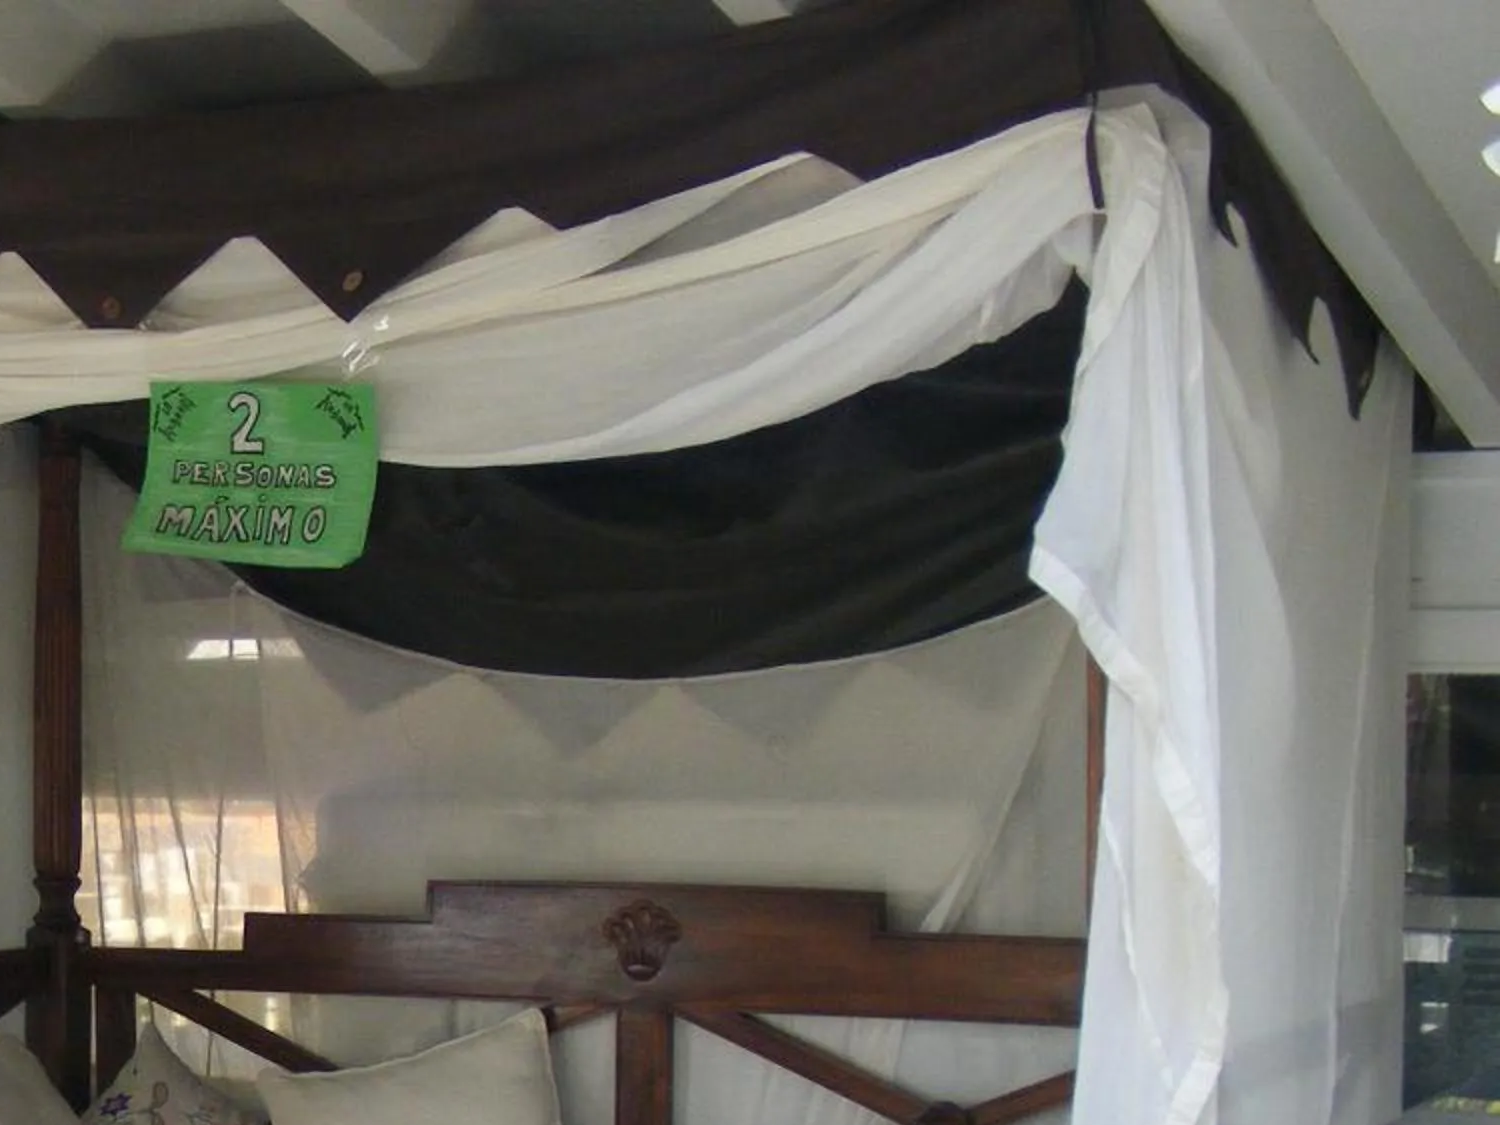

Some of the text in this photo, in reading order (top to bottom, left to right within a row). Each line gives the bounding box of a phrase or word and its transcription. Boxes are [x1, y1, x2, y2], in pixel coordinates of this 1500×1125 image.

[227, 391, 265, 455] 2
[171, 459, 337, 489] PERSONAS
[156, 495, 327, 545] MÁXIMO
